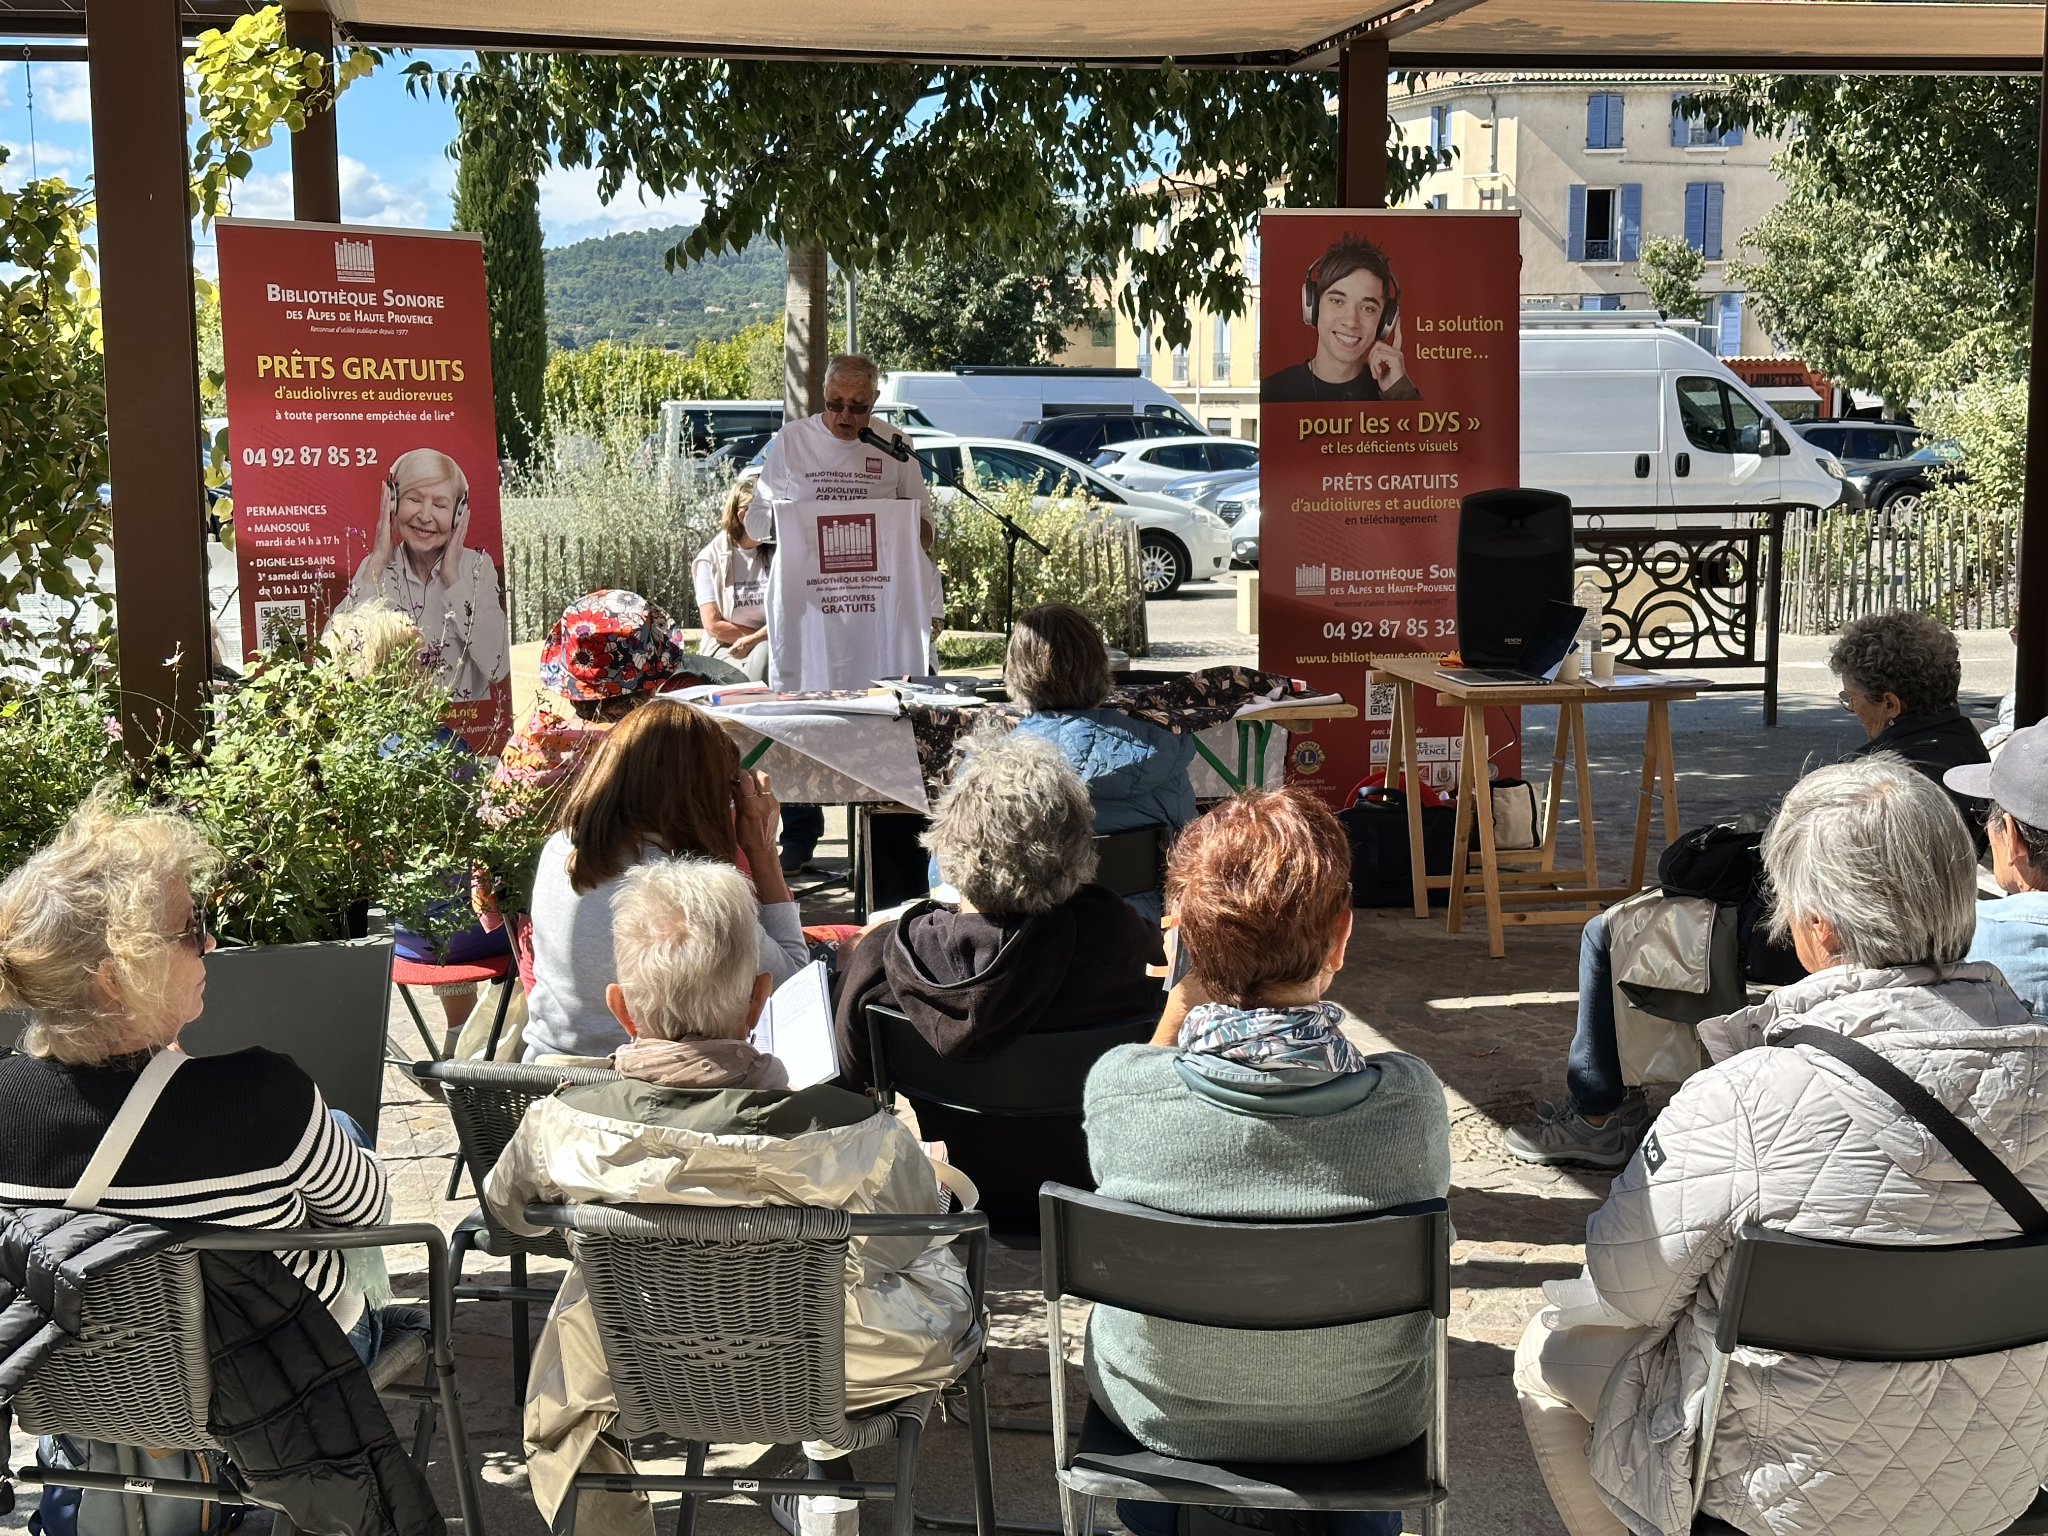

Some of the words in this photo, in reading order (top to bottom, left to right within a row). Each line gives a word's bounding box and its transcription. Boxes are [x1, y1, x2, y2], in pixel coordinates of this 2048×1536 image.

[382, 288, 445, 309] SONORE
[286, 309, 303, 321] DES
[306, 308, 336, 322] ALPES
[339, 311, 351, 322] DE
[354, 309, 385, 323] HAUTE
[387, 311, 433, 325] PROVENCE
[1416, 316, 1434, 332] La
[1438, 315, 1504, 332] solution
[256, 348, 336, 379] PRÊTS
[342, 357, 466, 382] GRATUITS
[1750, 373, 1804, 385] LUNETTES
[274, 386, 358, 401] d'audiolivres
[361, 387, 375, 401] et
[378, 387, 453, 402] audiorevues
[275, 409, 282, 421] à
[284, 410, 314, 421] toute
[315, 411, 364, 423] personne
[365, 408, 418, 424] empêchée
[419, 410, 432, 422] de
[1299, 416, 1353, 440] pour
[1359, 411, 1390, 433] les
[1418, 411, 1460, 433] DYS
[1320, 443, 1333, 454] et
[1336, 441, 1353, 454] les
[1356, 440, 1415, 454] déficients
[1418, 439, 1459, 453] visuels
[242, 447, 267, 467] 04
[271, 447, 296, 467] 92
[299, 445, 322, 467] 87
[327, 445, 350, 467] 85
[355, 447, 378, 467] 32
[854, 472, 882, 480] SONORE
[1322, 472, 1373, 491] PRÊTS
[1377, 473, 1459, 491] GRATUITS
[816, 486, 868, 495] AUDIOLIVRES
[246, 505, 328, 517] PERMANENCES
[1291, 497, 1381, 513] d'audiolivres
[1384, 498, 1400, 510] et
[1344, 515, 1357, 525] en
[1359, 513, 1437, 526] téléchargement
[254, 523, 311, 534] MANOSQUE
[255, 537, 283, 548] mardi
[284, 537, 296, 547] de
[297, 537, 307, 546] 14
[308, 536, 314, 546] h
[315, 536, 322, 545] à
[323, 536, 332, 545] 17
[333, 535, 340, 544] h
[256, 556, 336, 568] DIGNE-LES-BAINS
[267, 571, 300, 581] samedi
[301, 571, 313, 580] du
[860, 575, 891, 583] SONORE
[272, 585, 282, 595] 10
[284, 585, 291, 594] h
[292, 585, 298, 594] à
[299, 585, 308, 594] 12
[1330, 587, 1344, 595] DES
[1347, 584, 1372, 595] ALPES
[1375, 586, 1385, 594] DE
[821, 594, 876, 604] AUDIOLIVRES
[822, 603, 876, 614] GRATUITS
[1323, 622, 1346, 640] 04
[1351, 621, 1373, 640] 92
[1379, 618, 1401, 639] 87
[1406, 618, 1428, 638] 85
[1434, 618, 1456, 637] 32
[1304, 751, 1314, 763] L
[130, 1480, 148, 1488] VEGA
